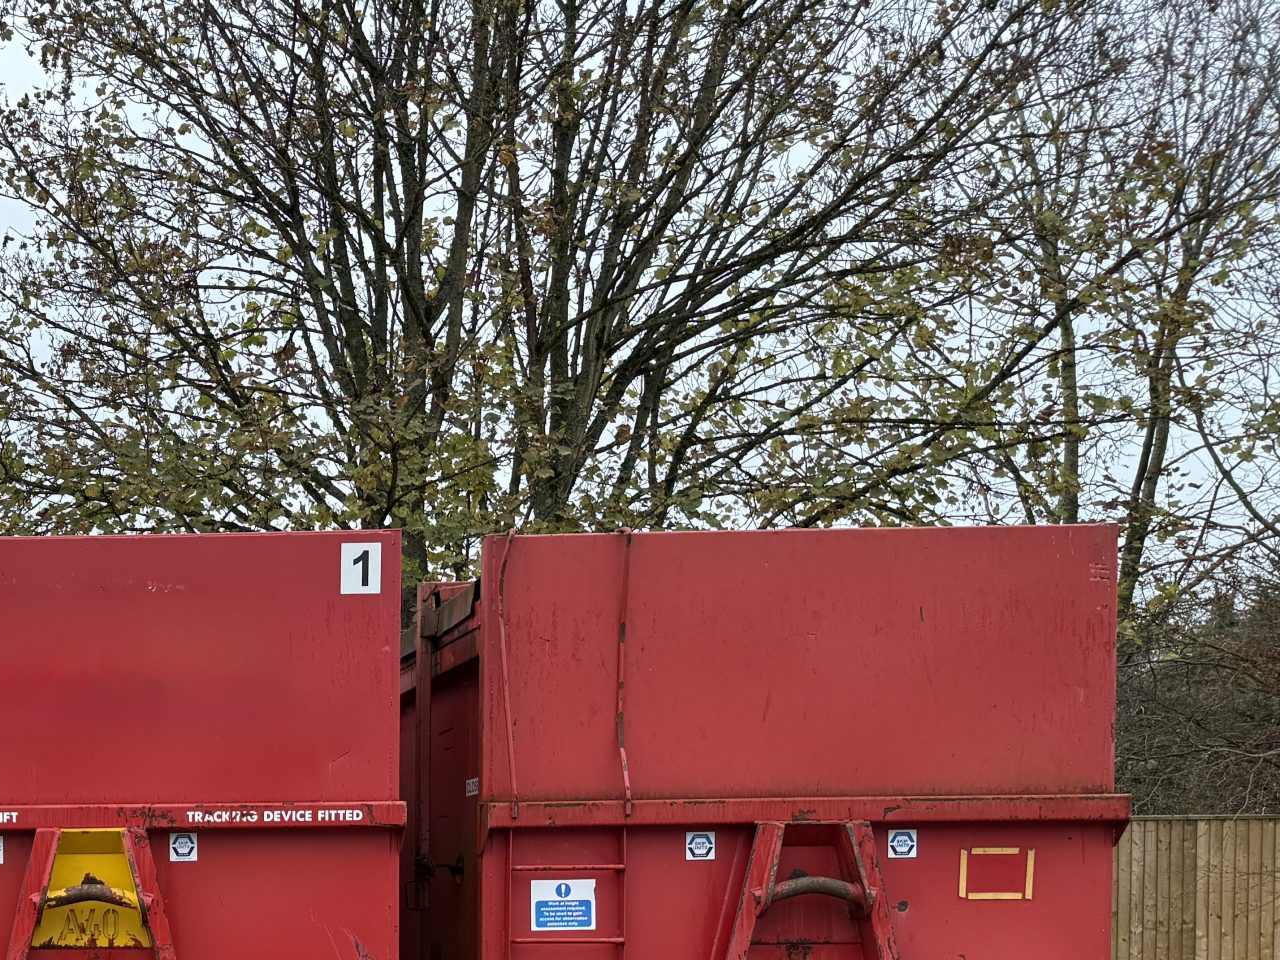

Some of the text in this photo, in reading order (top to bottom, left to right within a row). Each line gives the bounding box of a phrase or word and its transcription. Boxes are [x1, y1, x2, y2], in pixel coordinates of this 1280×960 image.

[353, 549, 369, 587] 1
[263, 810, 313, 822] DEVICE
[317, 809, 363, 822] FITTED
[58, 908, 120, 941] A40
